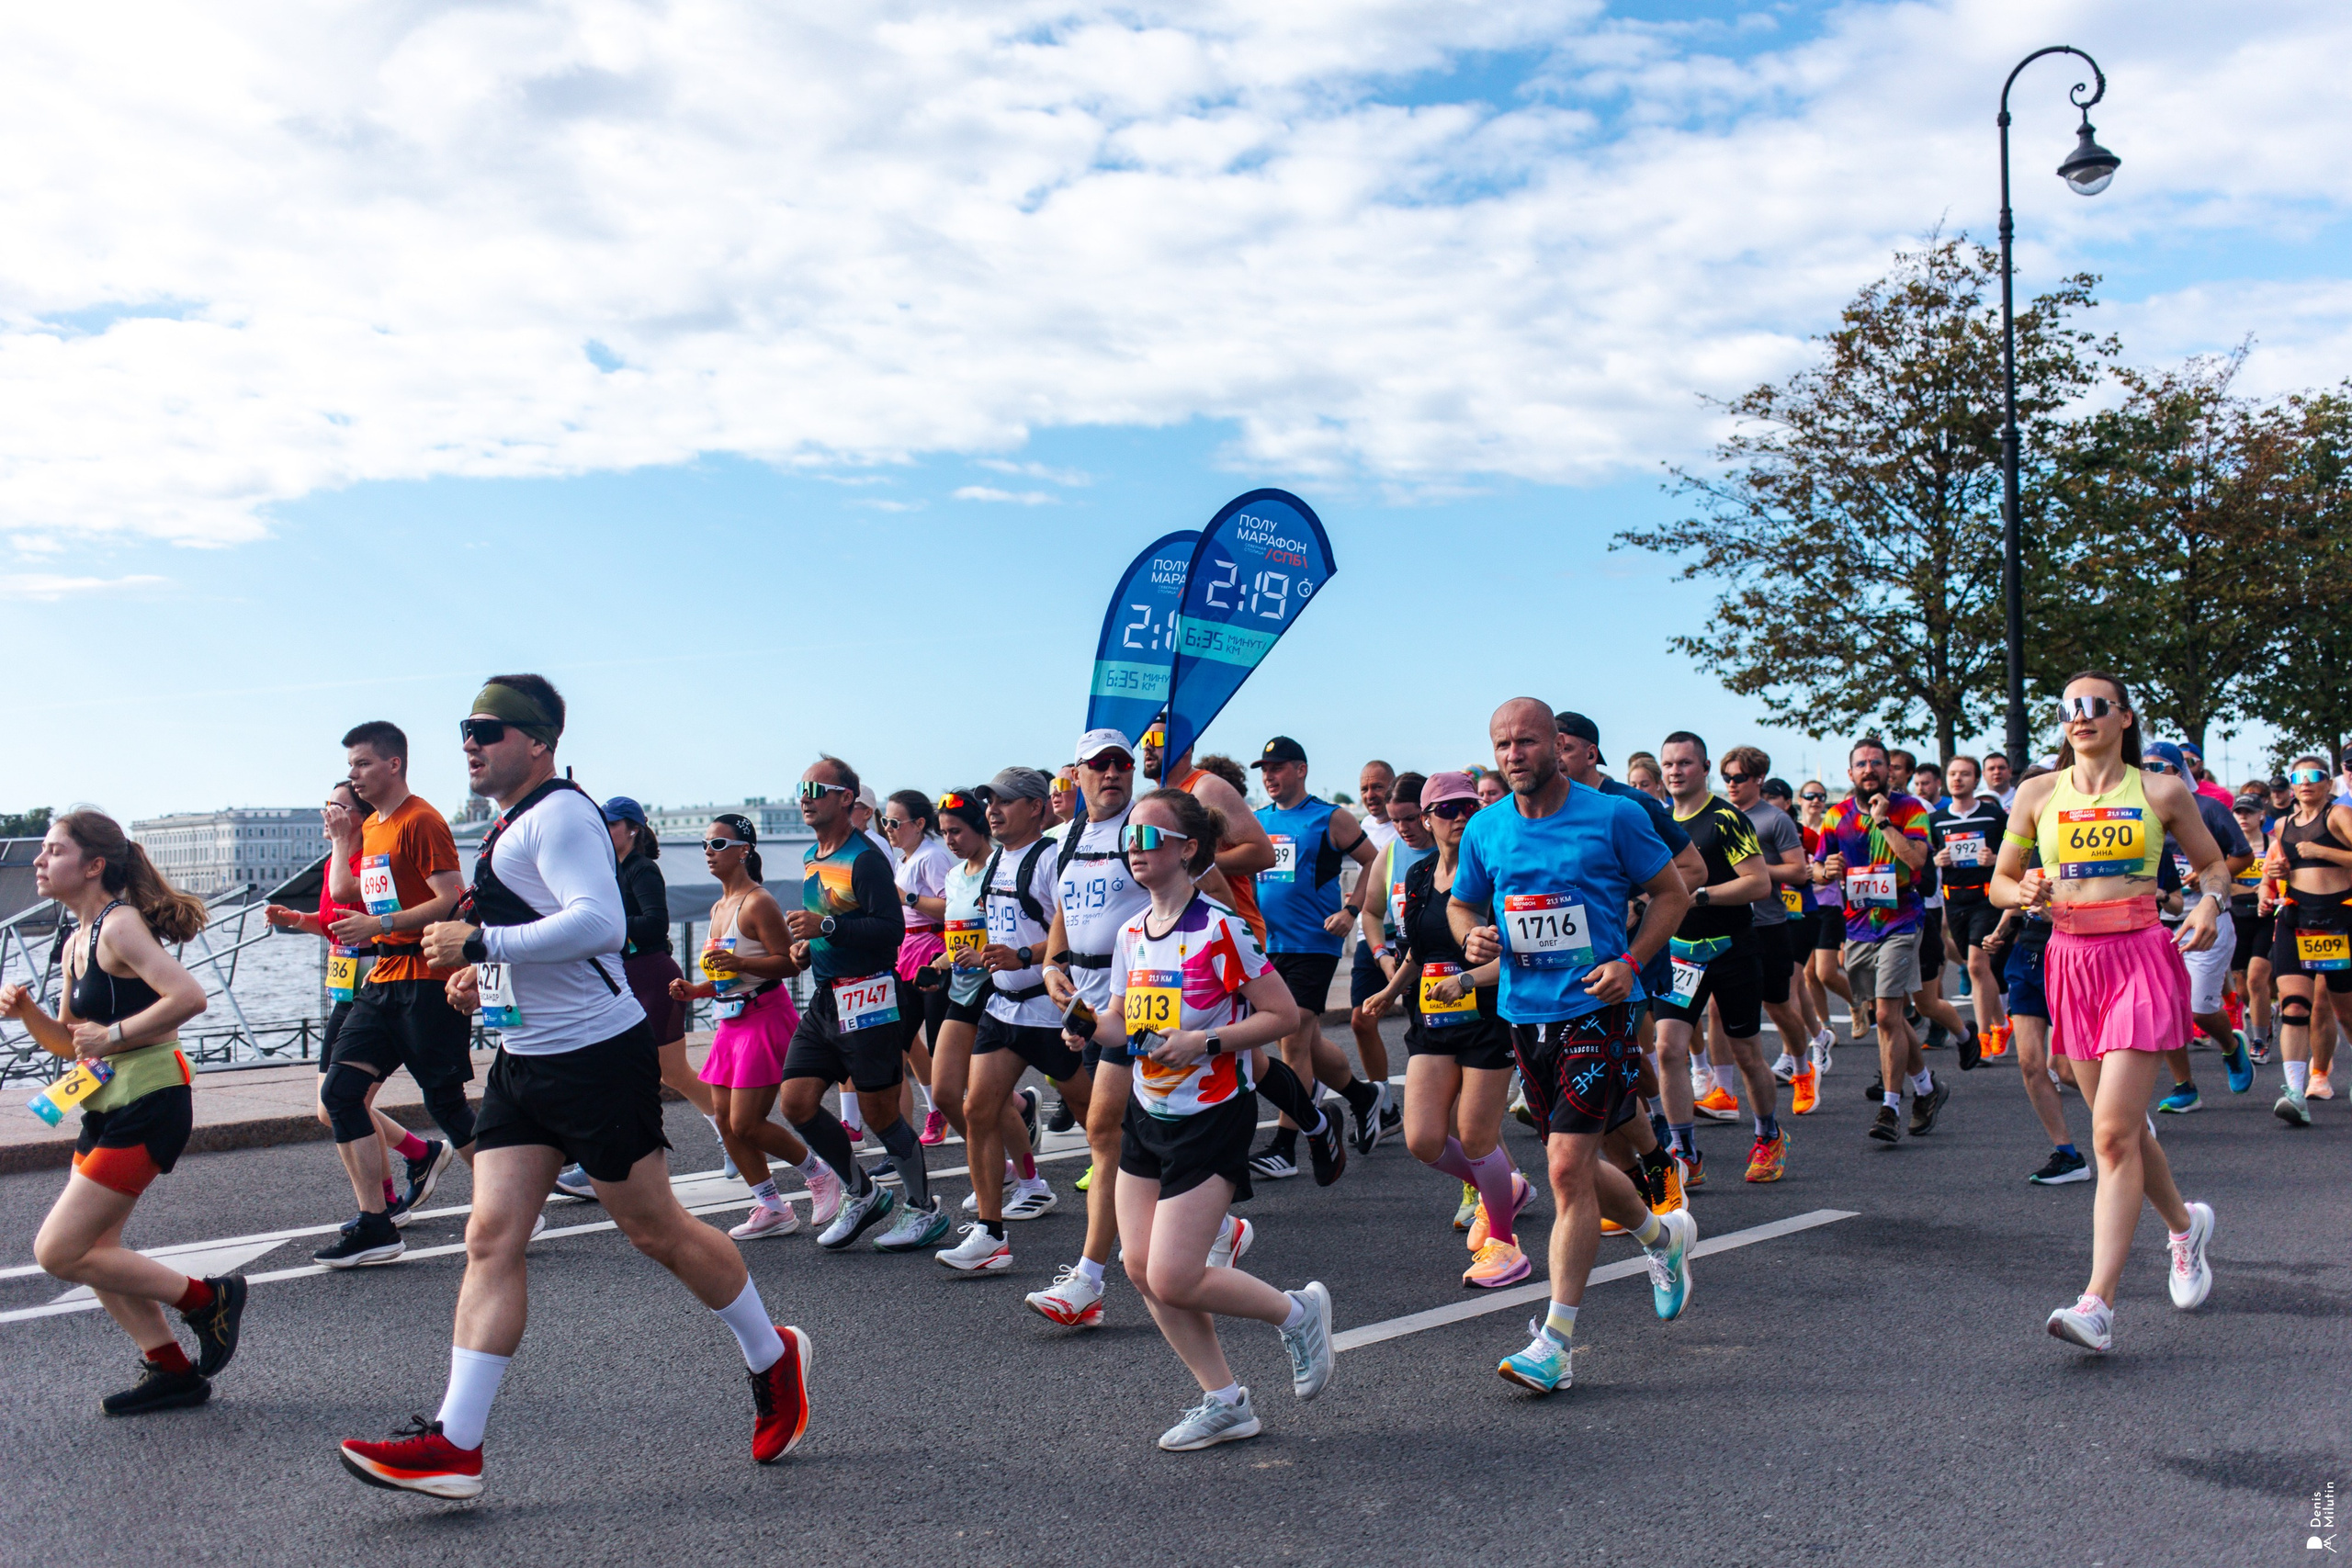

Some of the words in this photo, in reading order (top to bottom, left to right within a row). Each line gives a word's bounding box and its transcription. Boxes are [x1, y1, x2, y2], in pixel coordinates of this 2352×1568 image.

[1239, 514, 1277, 532] ПОЛУ
[1237, 528, 1307, 554] МАРАФОН
[1153, 559, 1189, 572] ПОЛУ
[1206, 559, 1288, 620] 2:19
[1123, 604, 1176, 650] 2:1
[1185, 627, 1223, 651] 6:35
[1227, 635, 1266, 650] МИНУТ/
[1226, 645, 1240, 655] КМ
[1106, 670, 1139, 689] 6:35
[1956, 842, 1977, 854] 992
[2070, 825, 2133, 849] 6690
[365, 875, 388, 895] 6969
[1064, 878, 1106, 910] 2:19
[1853, 880, 1889, 894] 7716
[988, 905, 1016, 932] 2:19
[1517, 913, 1576, 939] 1716
[2304, 939, 2342, 953] 5609
[843, 983, 887, 1011] 7747
[1127, 994, 1169, 1020] 6313
